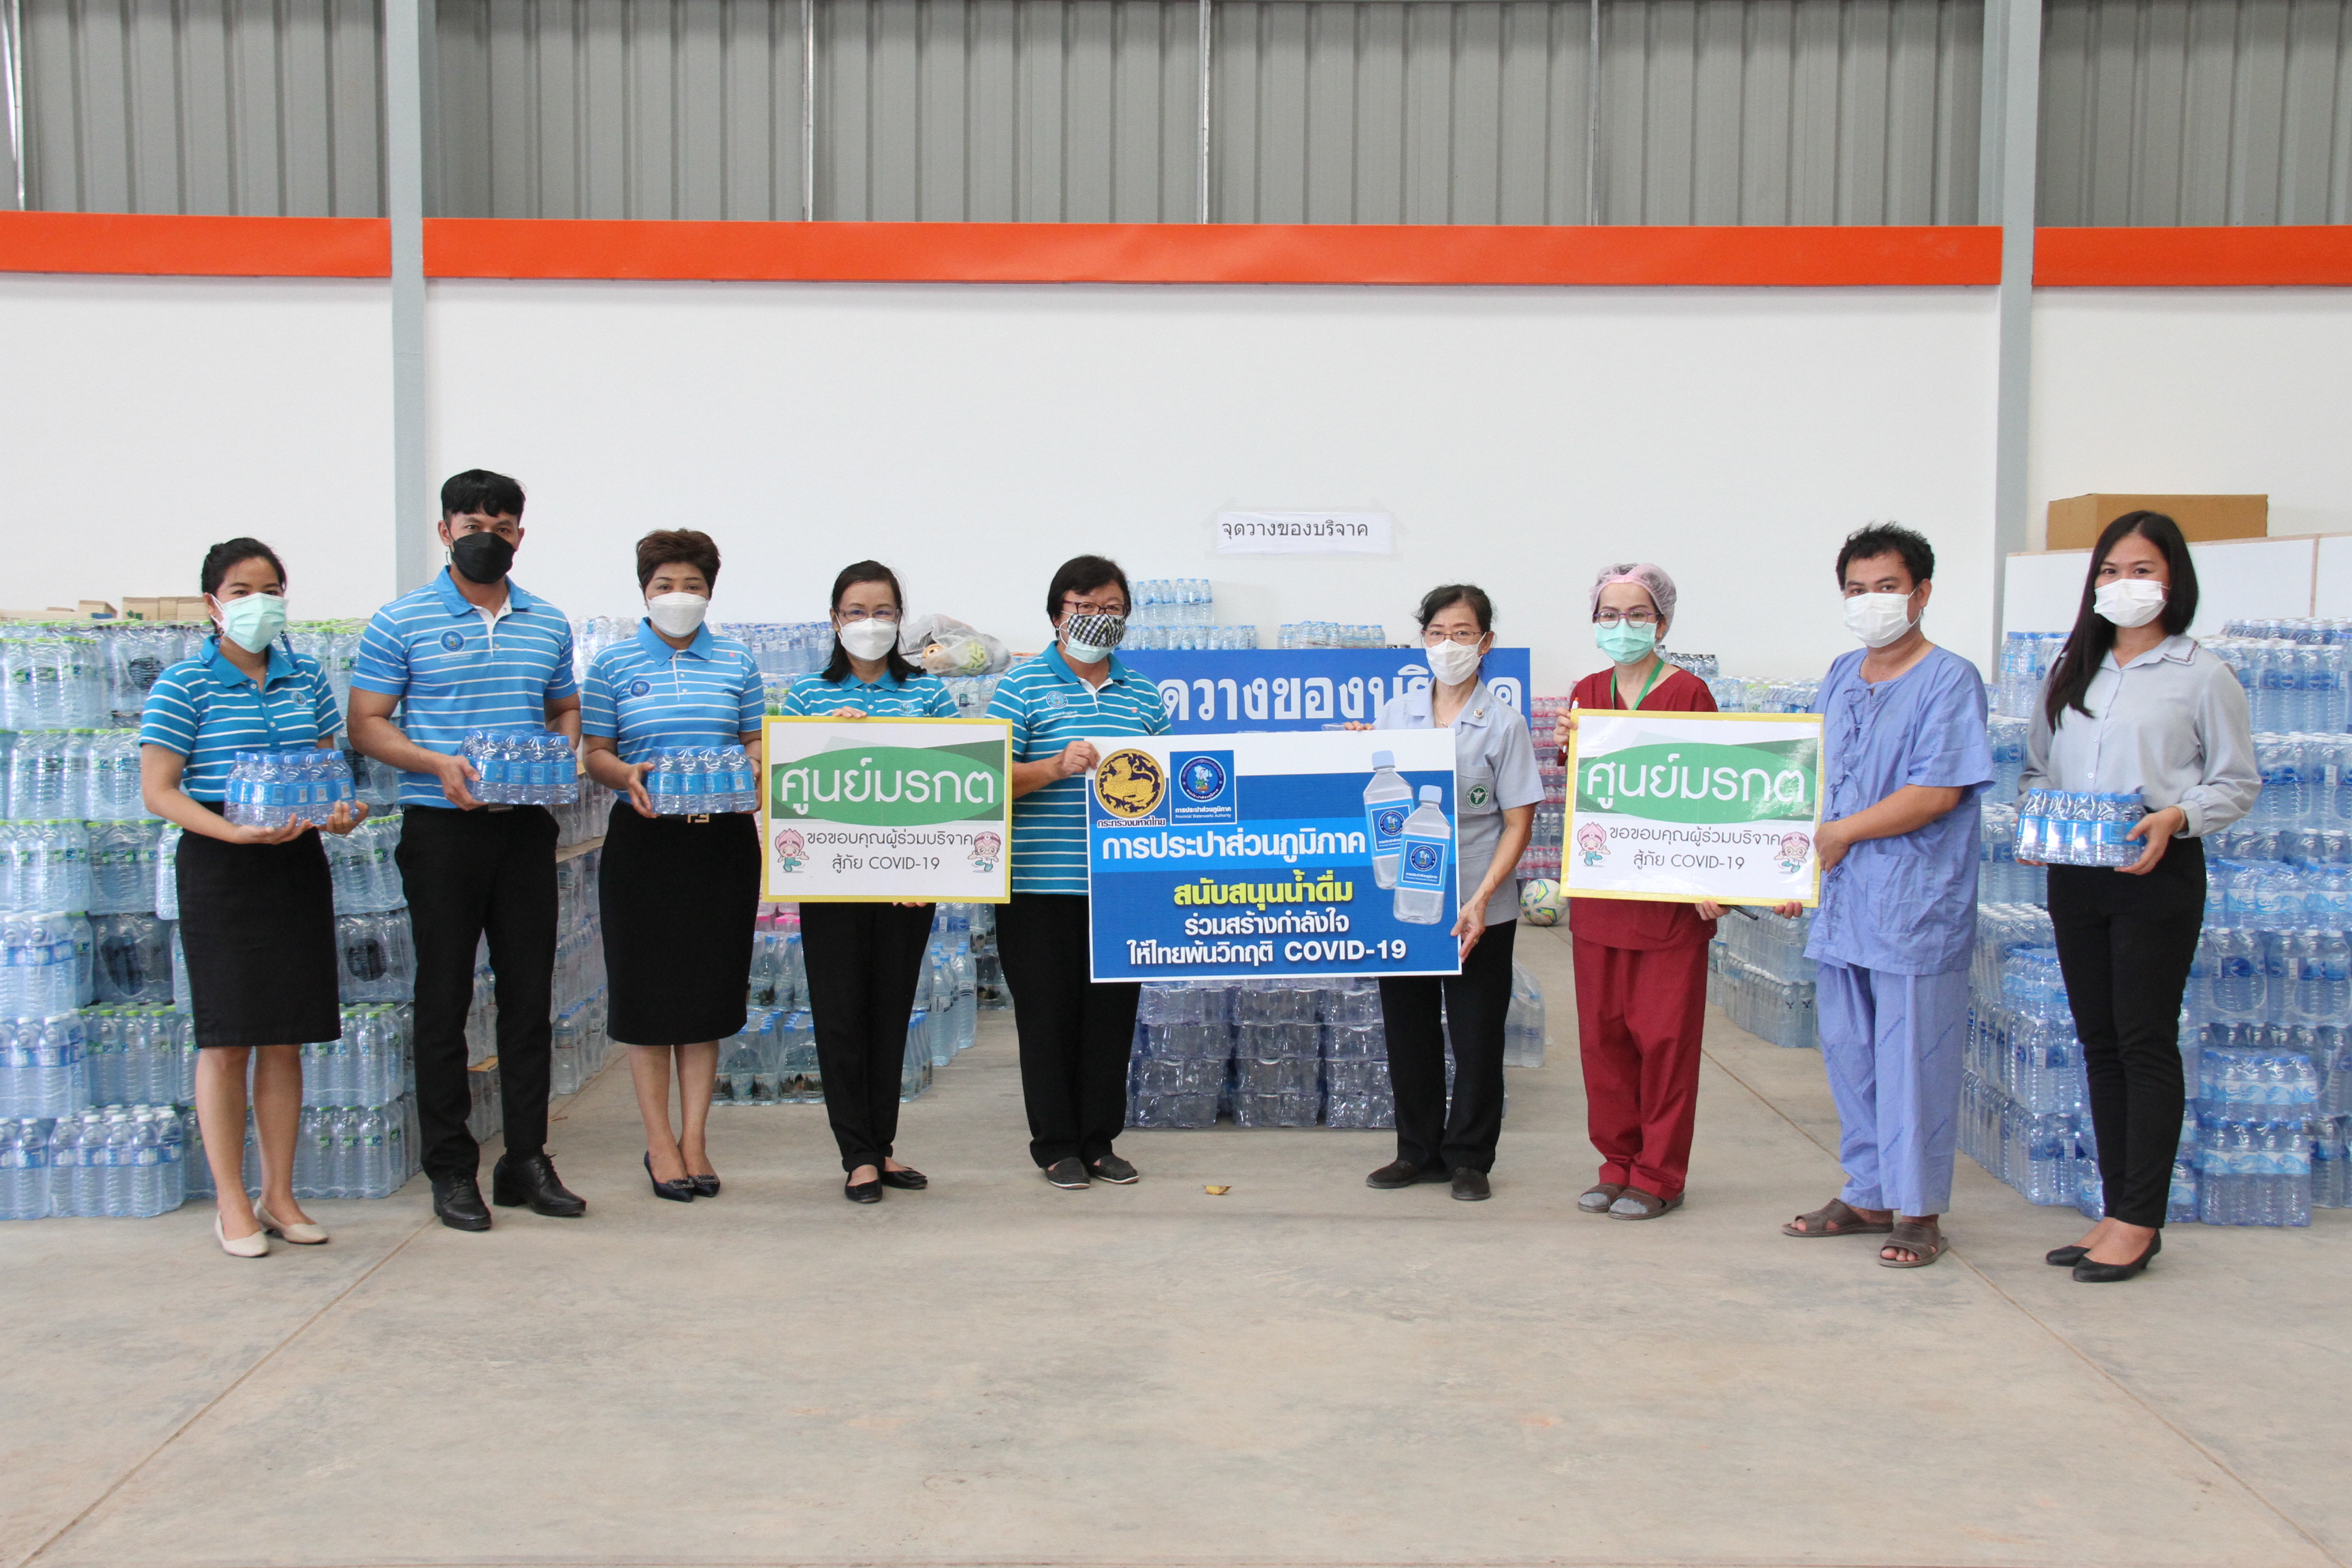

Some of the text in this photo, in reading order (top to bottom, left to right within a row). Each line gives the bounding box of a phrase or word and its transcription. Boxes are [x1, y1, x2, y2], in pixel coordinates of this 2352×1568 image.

[1222, 519, 1368, 540] จุดวางของบริจาค
[781, 757, 994, 815] ศูนย์มรกต
[1587, 753, 1806, 809] ศูนย์มรกต
[1098, 816, 1165, 828] กระทรวงมหาดไทย
[807, 829, 973, 848] ขอขอบคุณผู้ร่วมบริจาค
[1102, 828, 1366, 863] การประปาส่วนภูมิภาค
[1610, 826, 1780, 847] ขอขอบคุณผู้ร่วมบริจาค
[869, 856, 940, 870] COVID-19
[1671, 854, 1744, 870] COVID-19
[1173, 870, 1353, 911] สนับสนุนน้ำดื่ม
[1185, 908, 1349, 936] ร่วมสร้างกำลังใจ
[1126, 939, 1406, 967] ให้ไทยพ้นวิกฤติ COVID-19
